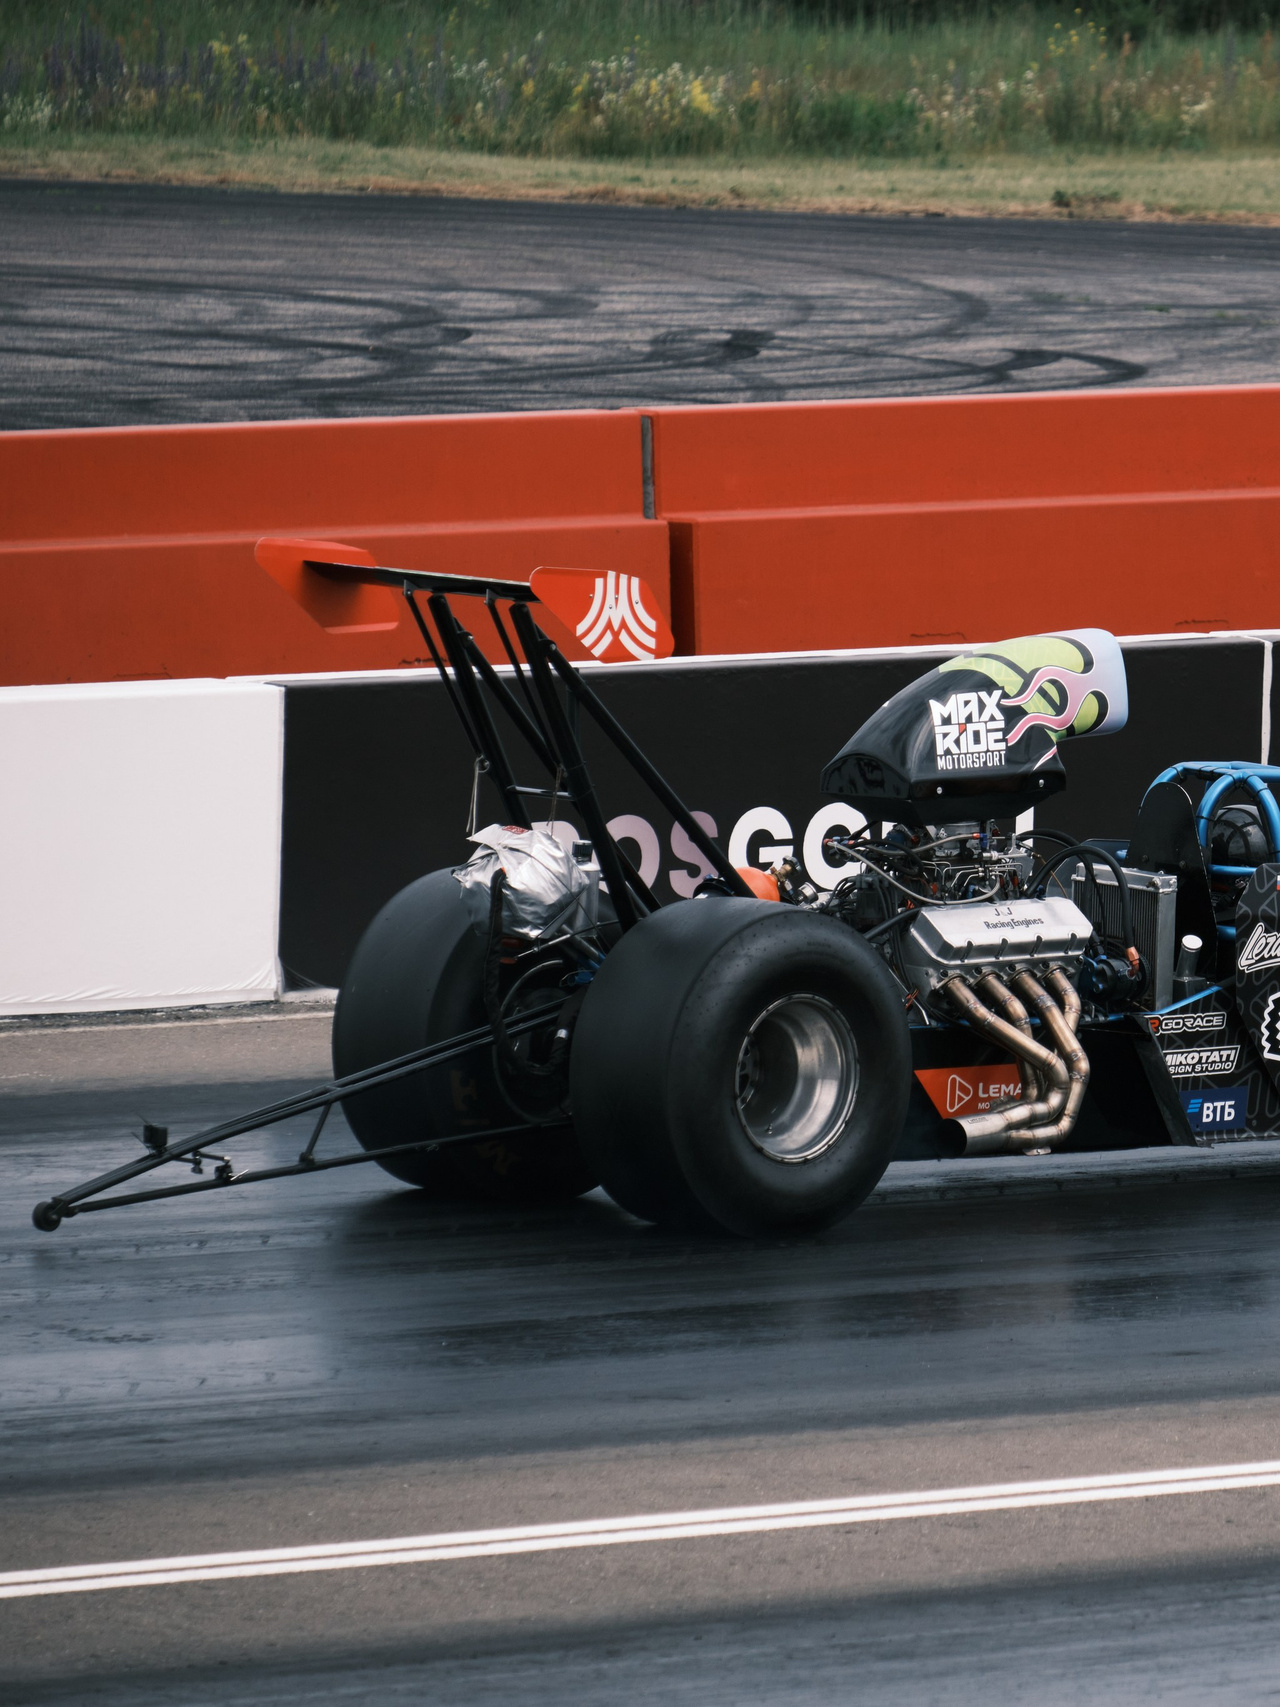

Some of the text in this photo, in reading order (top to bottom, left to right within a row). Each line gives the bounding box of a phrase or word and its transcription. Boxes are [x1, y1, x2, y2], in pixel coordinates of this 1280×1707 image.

[929, 690, 1004, 725] MAX
[937, 751, 1005, 770] MOTORSPORT
[1169, 1062, 1232, 1074] SIGN STUDIO
[979, 1082, 1022, 1098] LEMA
[1202, 1101, 1235, 1123] ВТБ
